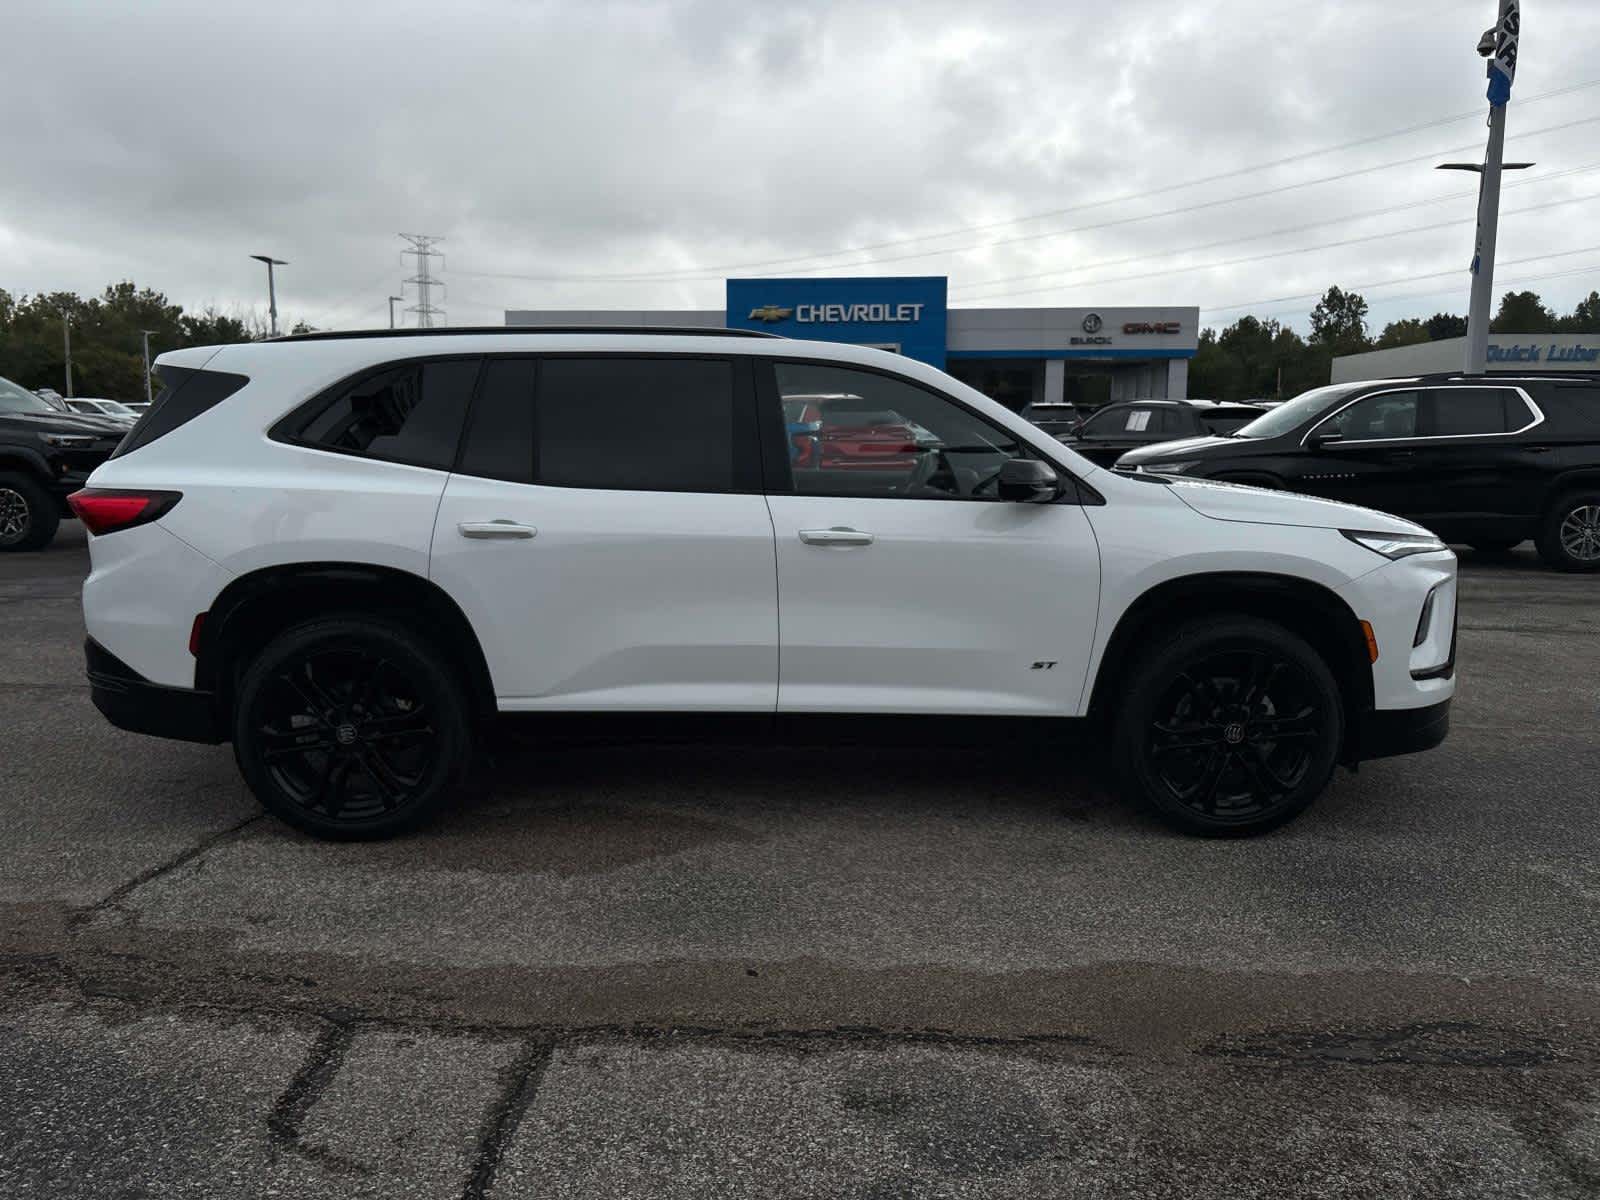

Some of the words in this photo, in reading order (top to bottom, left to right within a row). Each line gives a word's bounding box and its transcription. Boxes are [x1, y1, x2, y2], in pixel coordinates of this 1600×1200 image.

[796, 303, 924, 322] CHEVROLET
[1122, 322, 1181, 335] GMC
[1070, 336, 1113, 345] BUICK
[1030, 661, 1058, 670] ST
